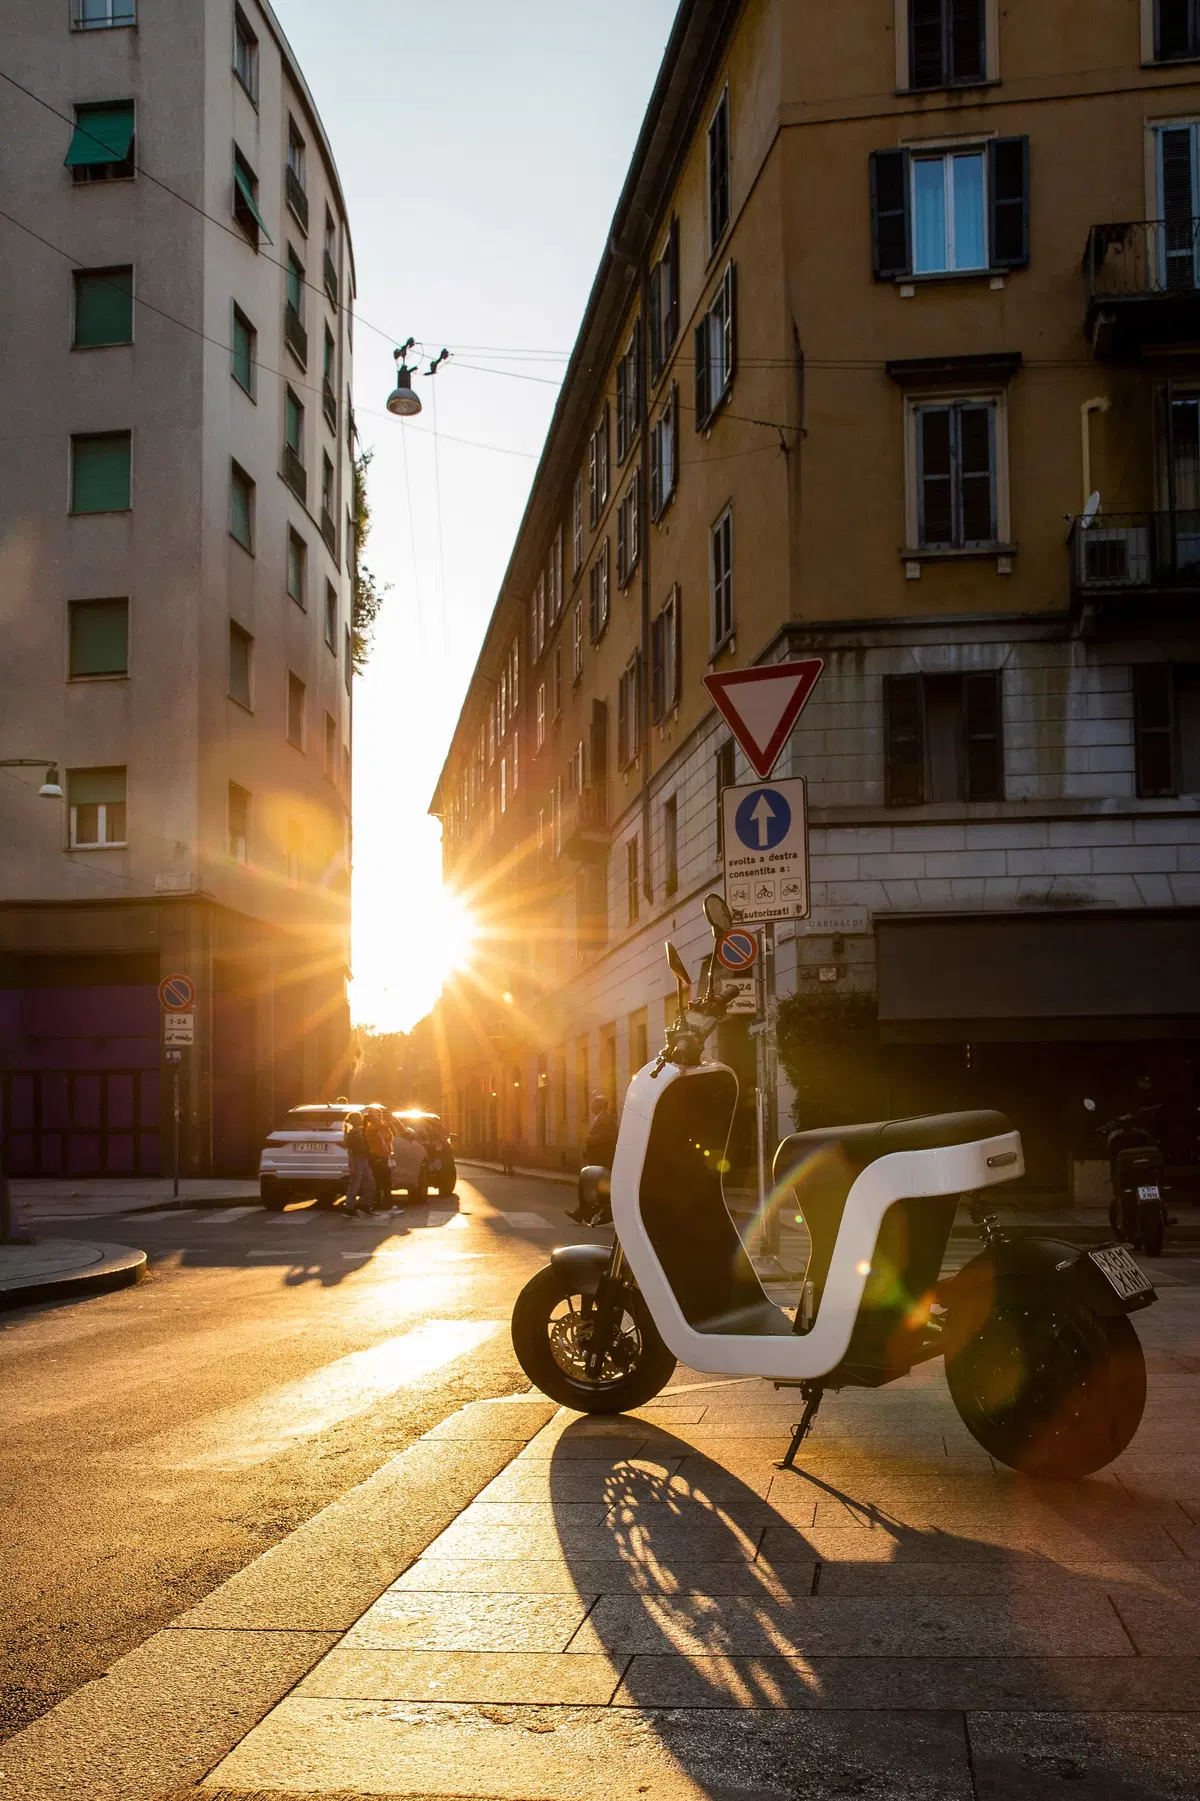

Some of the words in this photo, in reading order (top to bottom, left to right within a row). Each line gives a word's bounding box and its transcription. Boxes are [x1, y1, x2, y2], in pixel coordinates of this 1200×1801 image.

[728, 857, 756, 867] svolta
[768, 851, 798, 862] destra
[728, 866, 776, 879] consentita
[743, 906, 789, 919] autorizzati
[808, 919, 864, 929] GARIBALDI
[1098, 1249, 1134, 1272] X8M
[1114, 1268, 1149, 1293] XNM
